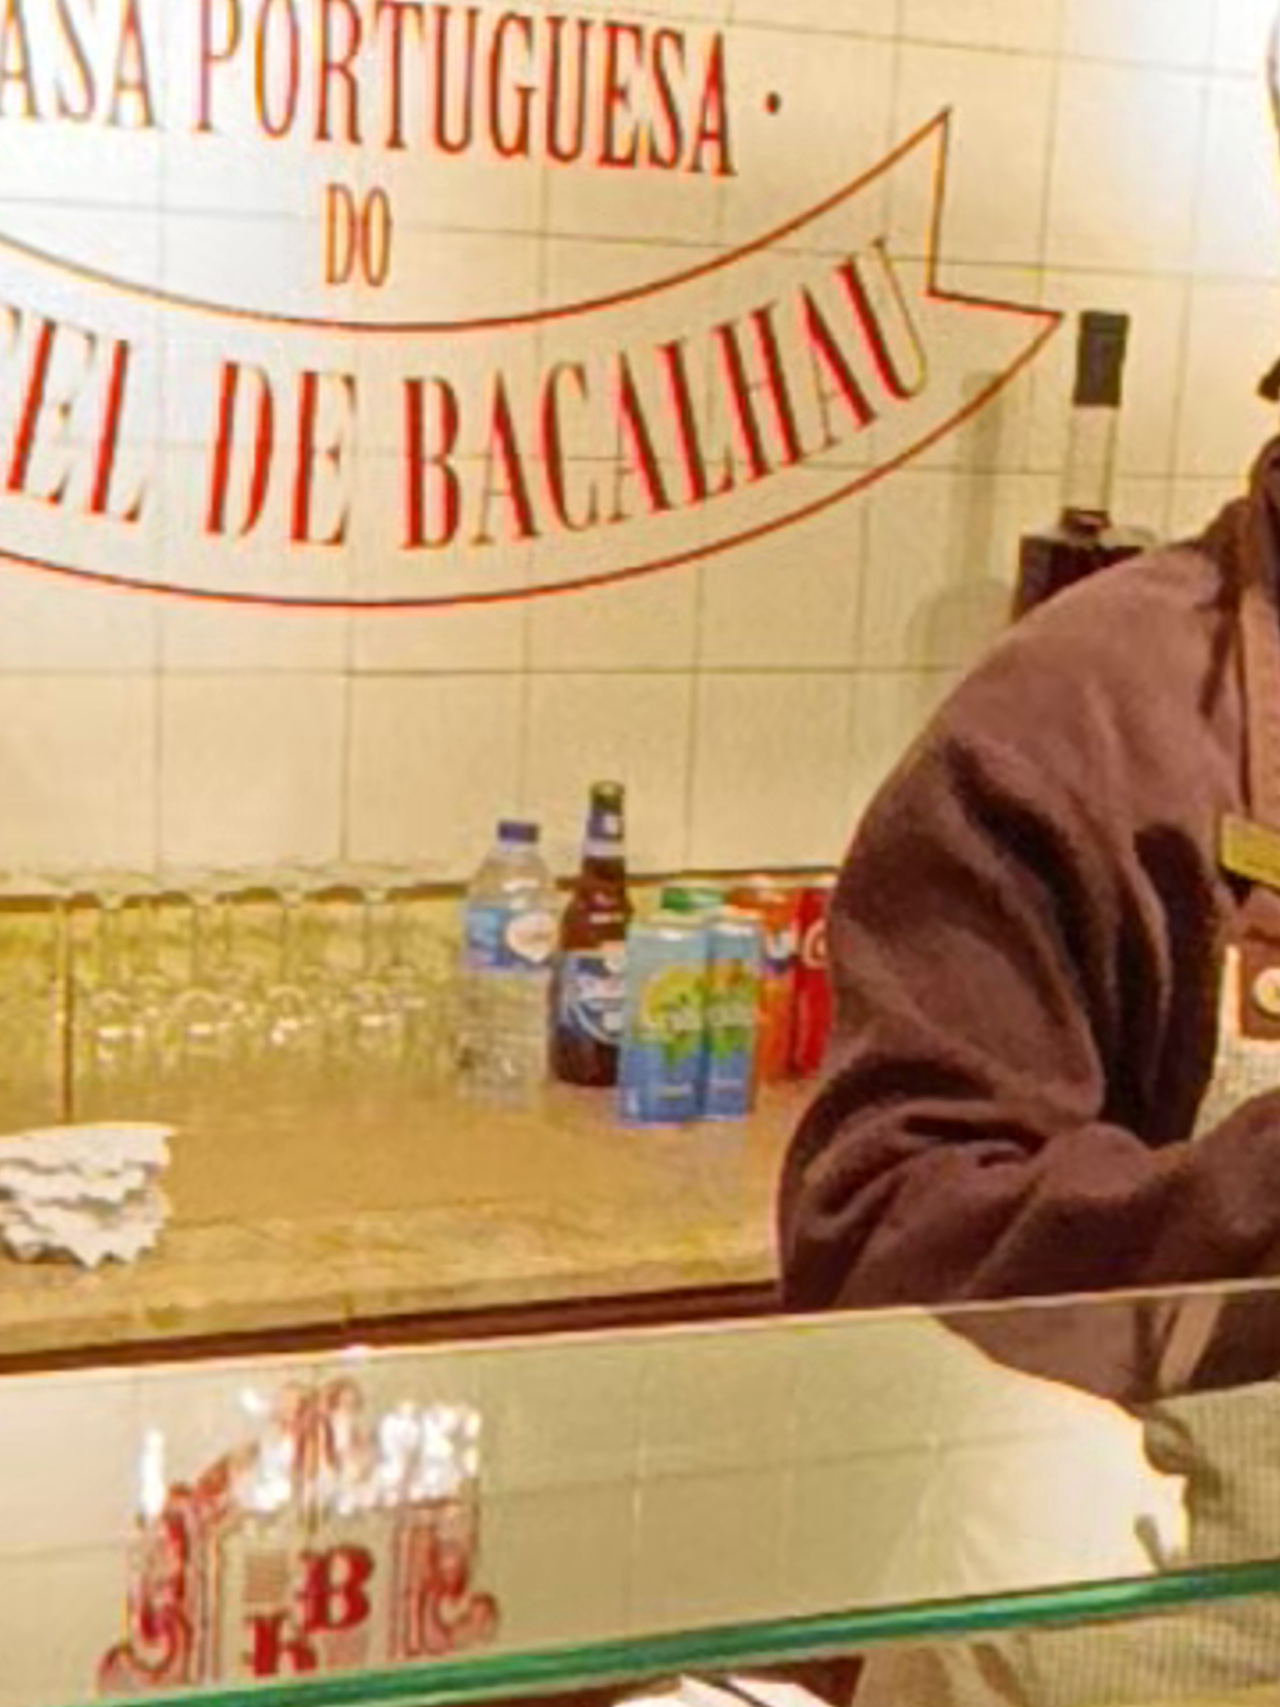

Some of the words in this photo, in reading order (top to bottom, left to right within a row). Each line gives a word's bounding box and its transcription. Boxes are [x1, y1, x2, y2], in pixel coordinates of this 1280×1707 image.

[324, 182, 392, 287] DO
[205, 359, 358, 547] DE
[399, 237, 928, 550] BACALHAU
